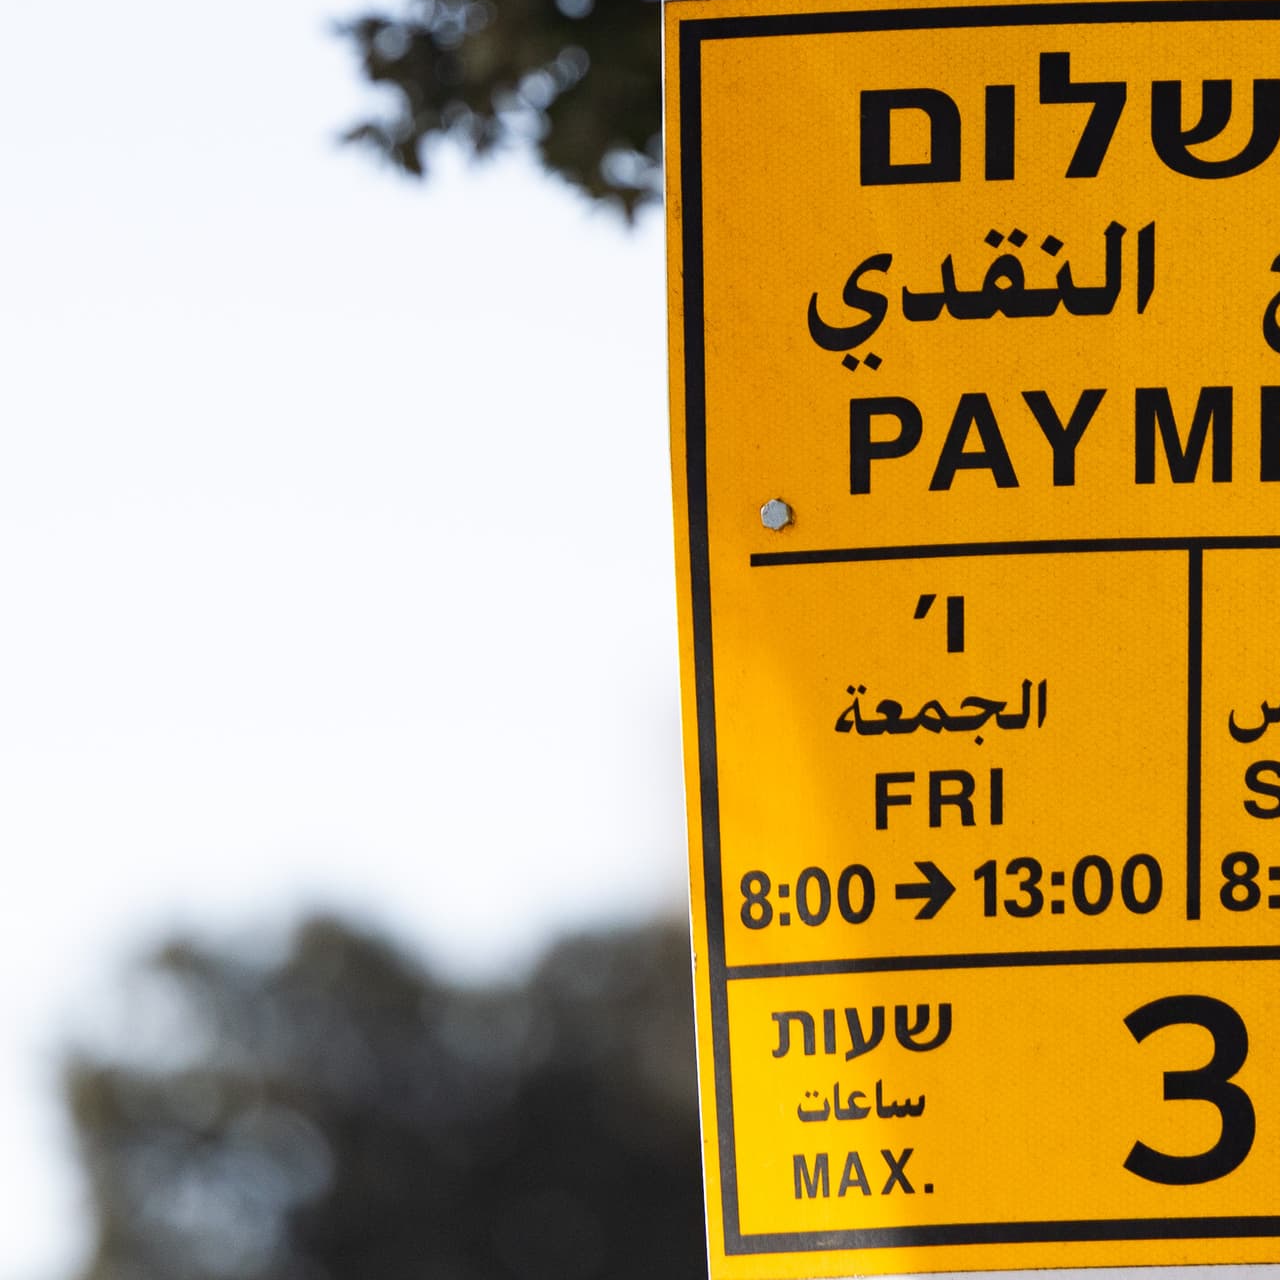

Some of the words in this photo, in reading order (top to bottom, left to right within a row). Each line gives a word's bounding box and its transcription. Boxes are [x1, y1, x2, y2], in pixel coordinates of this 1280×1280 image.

[807, 220, 1156, 372] النقدي
[834, 678, 1047, 736] الجمعة
[875, 767, 1004, 831] FRI
[740, 863, 876, 930] 8:00
[973, 853, 1163, 919] 13:00
[772, 1003, 953, 1061] שעות
[797, 1079, 926, 1122] ساعات
[1123, 994, 1256, 1186] 3
[793, 1148, 934, 1199] MAX.
